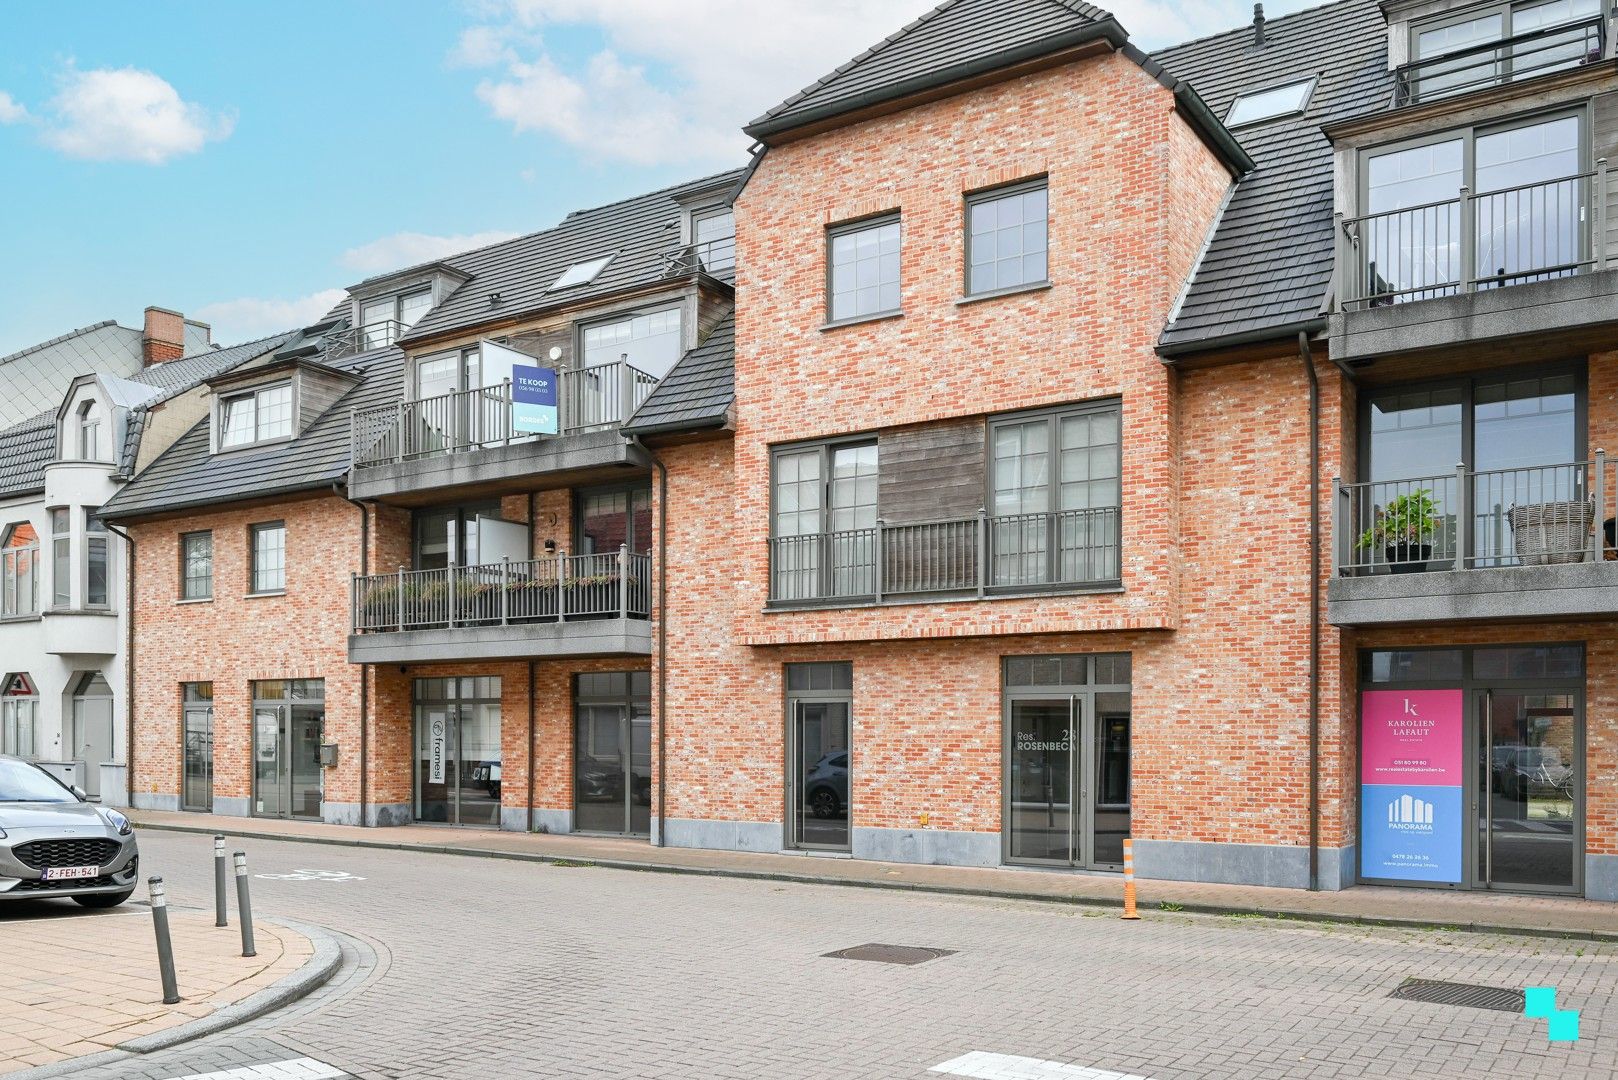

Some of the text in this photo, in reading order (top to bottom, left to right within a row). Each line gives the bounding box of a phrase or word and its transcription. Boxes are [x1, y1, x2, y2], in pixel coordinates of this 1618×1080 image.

[518, 377, 548, 387] TE KOOP
[1017, 731, 1036, 741] Res.
[1393, 728, 1430, 736] LAFAUT
[434, 737, 444, 780] framesi
[1388, 823, 1433, 831] PANORAMA
[48, 867, 97, 878] 2-FEH-541
